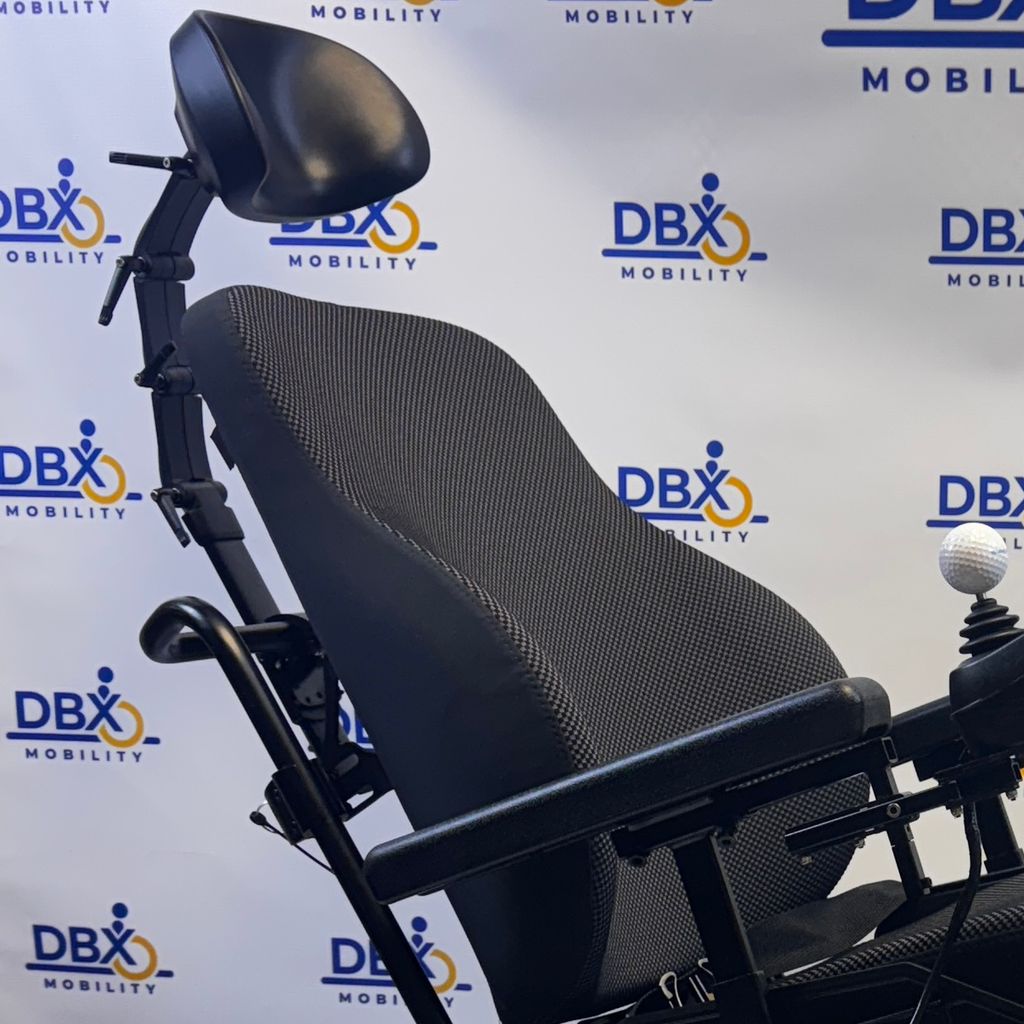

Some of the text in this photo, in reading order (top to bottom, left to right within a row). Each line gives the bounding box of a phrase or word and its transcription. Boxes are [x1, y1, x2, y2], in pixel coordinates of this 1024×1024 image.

[312, 5, 440, 22] MOBILITY
[566, 10, 692, 23] MOBILITY
[614, 202, 727, 247] DBX
[6, 251, 104, 264] OBILITY
[289, 255, 415, 270] MOBILITY
[622, 267, 747, 282] MOBILITY
[0, 446, 106, 487] DBX
[618, 466, 730, 511] DBX
[6, 505, 125, 519] MOBILITY
[664, 528, 749, 543] BILITY
[15, 691, 123, 732] DBX
[26, 748, 141, 762] MOBILITY
[32, 920, 136, 965] DBX
[44, 978, 155, 994] MOBILITY
[339, 993, 454, 1007] MOBIY
